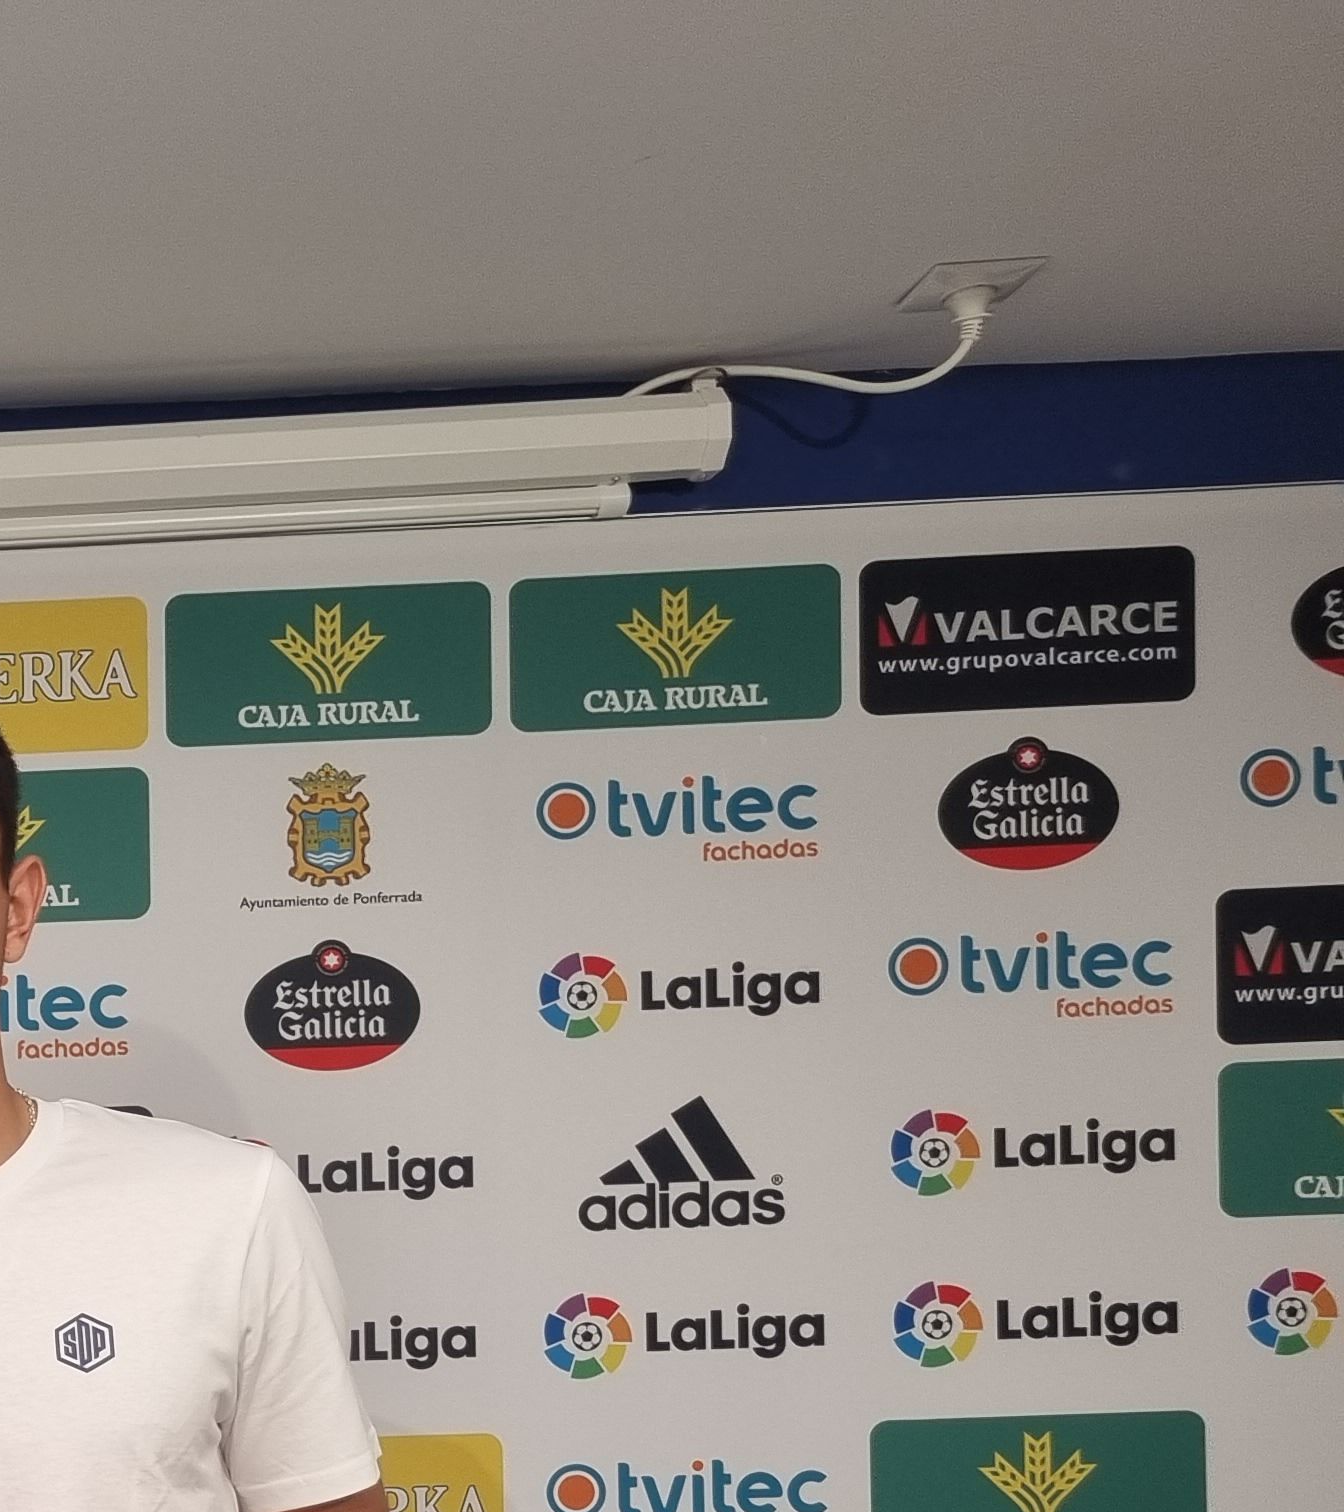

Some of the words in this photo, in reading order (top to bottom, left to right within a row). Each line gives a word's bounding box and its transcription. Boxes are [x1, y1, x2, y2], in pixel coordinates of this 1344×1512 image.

[934, 600, 1178, 643] VALCARCE
[878, 643, 1177, 677] www.grupovalcarce.com
[238, 702, 310, 729] CAJA
[318, 699, 419, 726] RURAL
[583, 687, 657, 714] CAJA
[664, 683, 767, 710] RURAL
[609, 774, 817, 838] tvitec
[969, 776, 1089, 811] Estrella
[973, 808, 1084, 840] Galicia
[703, 839, 818, 862] fachadas
[240, 895, 328, 911] Ayuntamiento
[332, 892, 348, 906] de
[353, 890, 423, 906] Ponferrada
[960, 930, 1172, 992] tvitec
[273, 977, 391, 1012] Estrella
[640, 961, 820, 1017] LaLiga
[278, 1008, 387, 1041] Galicia
[1056, 995, 1173, 1019] fachadas
[16, 1037, 128, 1061] fachadas
[992, 1117, 1175, 1174] LaLiga
[298, 1146, 474, 1200] LaLiga
[578, 1179, 786, 1232] adidas
[645, 1303, 824, 1359] LaLiga
[997, 1290, 1178, 1346] LaLiga
